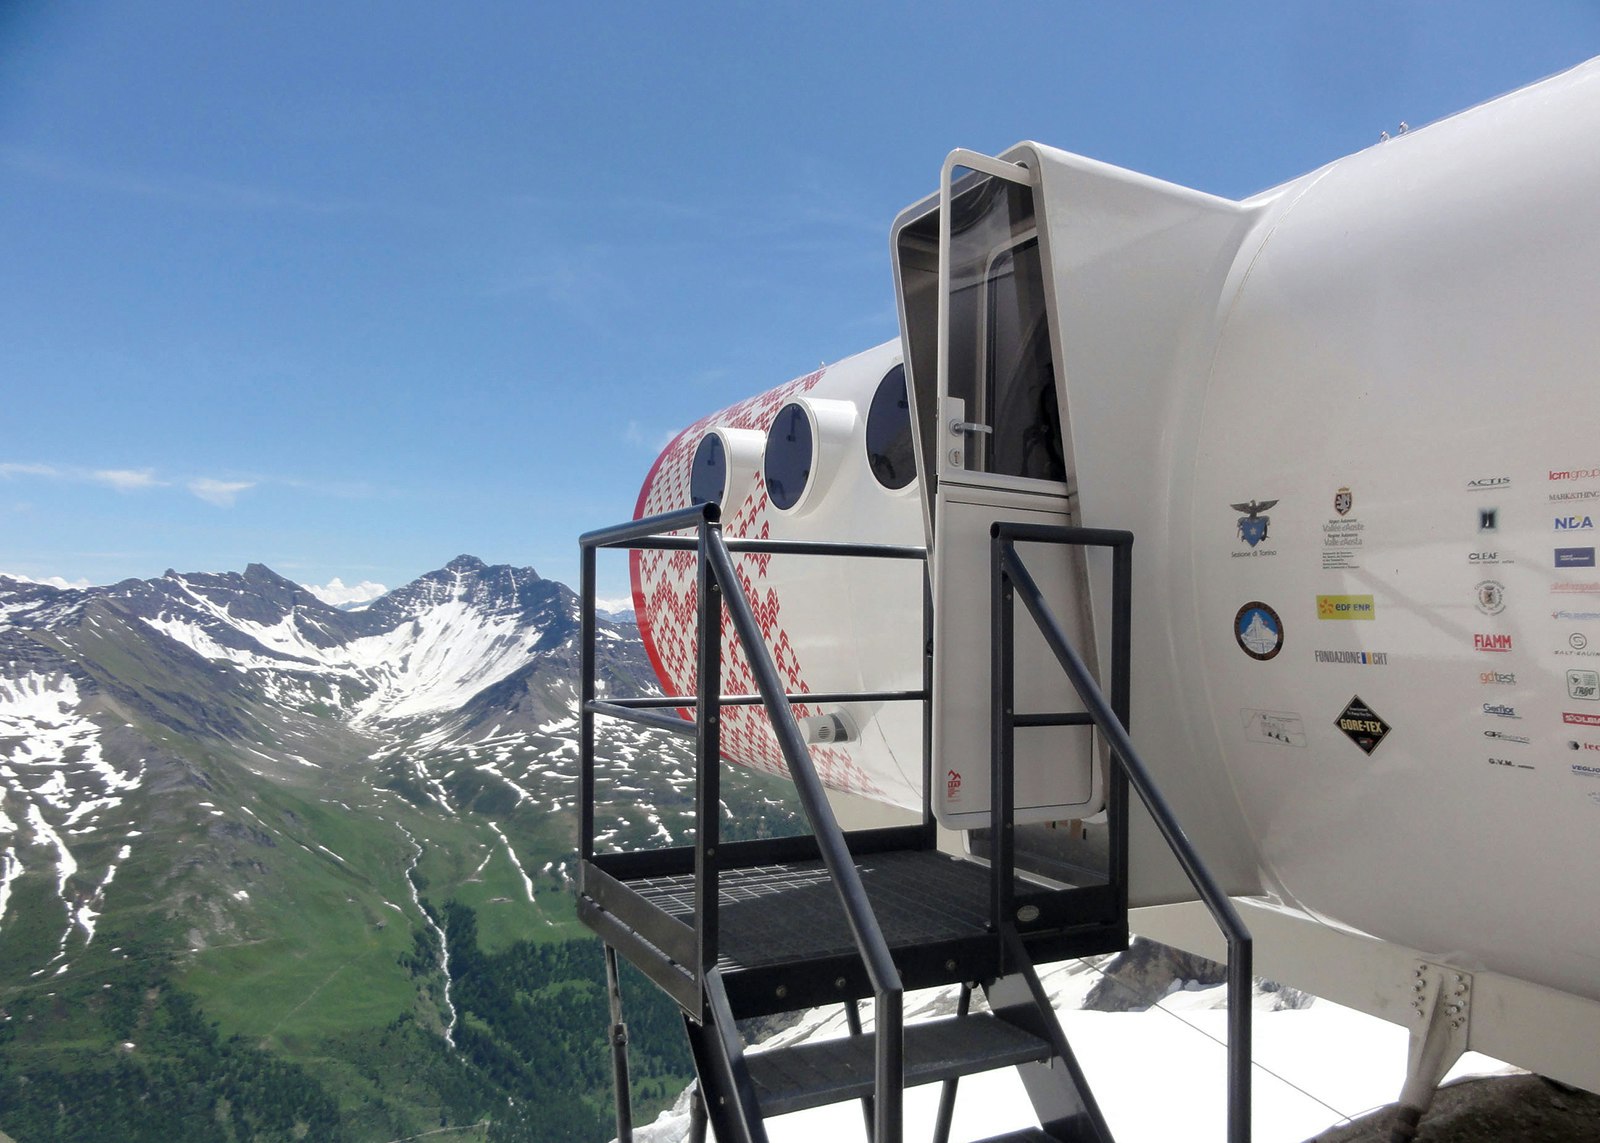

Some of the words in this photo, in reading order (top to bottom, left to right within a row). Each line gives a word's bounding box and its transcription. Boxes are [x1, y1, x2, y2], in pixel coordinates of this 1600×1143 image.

[1467, 477, 1511, 487] ACTIS
[1554, 516, 1594, 529] NDA
[1353, 603, 1371, 611] ENR
[1474, 633, 1512, 649] FIAMM
[1315, 650, 1361, 665] FONDAZIONE
[1372, 652, 1387, 665] CRT
[1340, 719, 1382, 733] GORE-TEX
